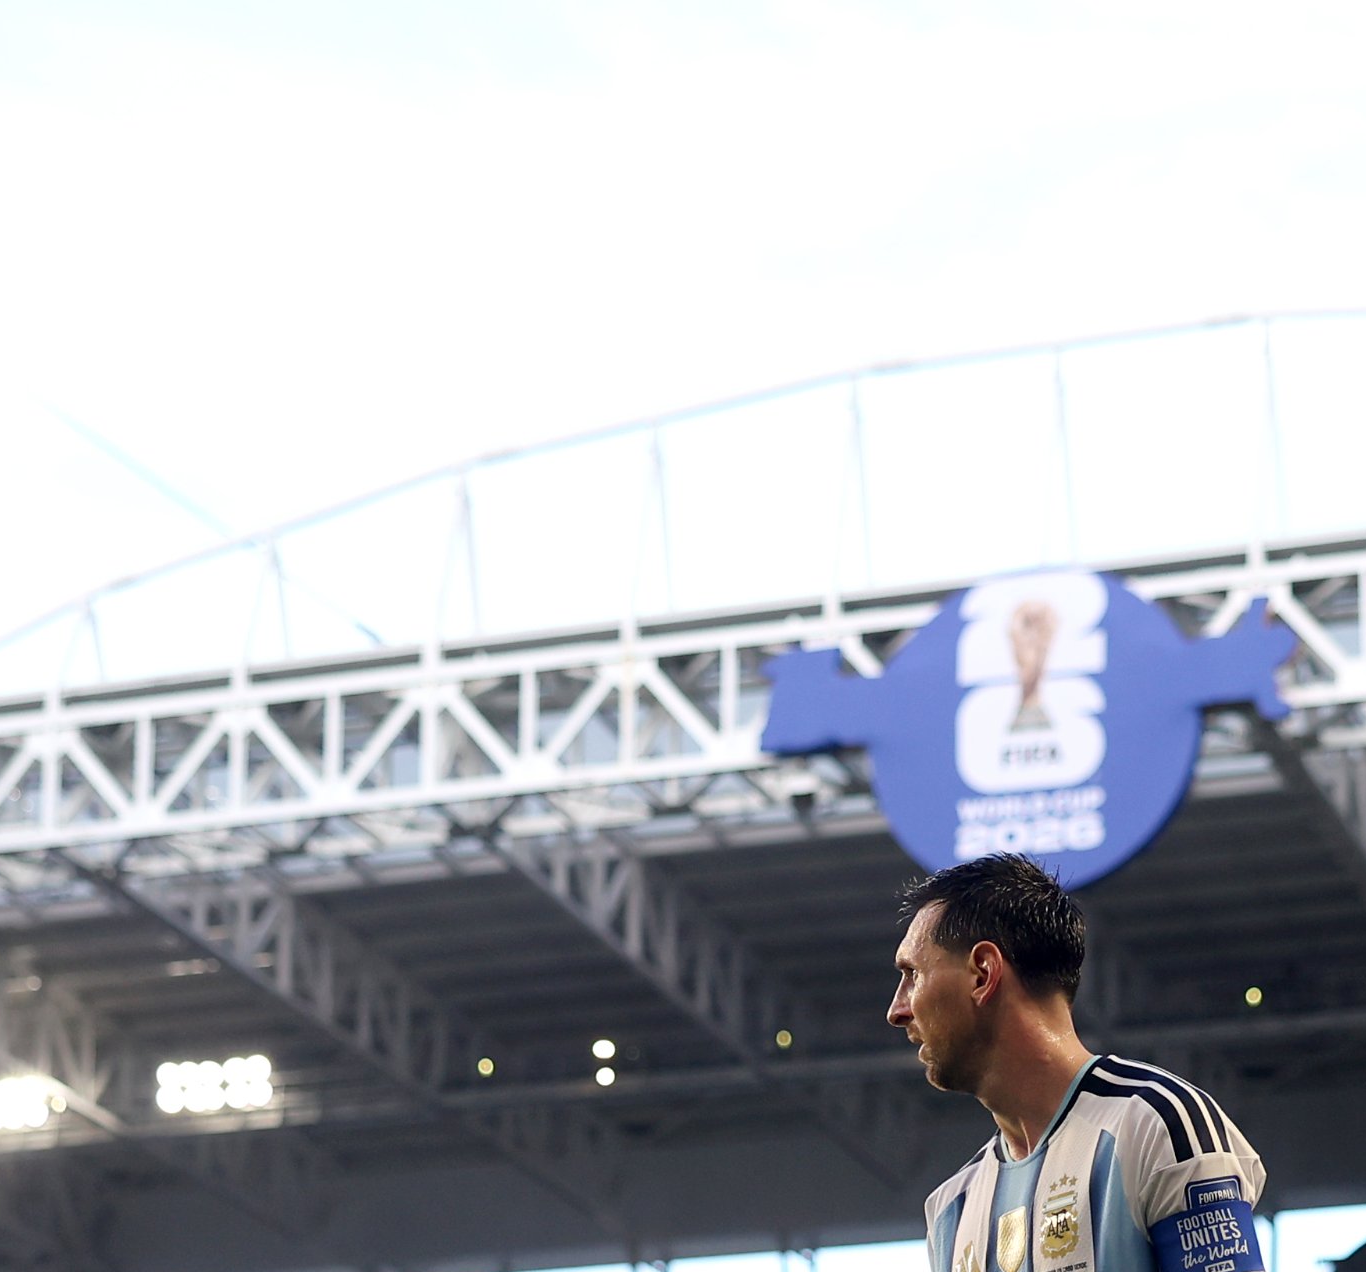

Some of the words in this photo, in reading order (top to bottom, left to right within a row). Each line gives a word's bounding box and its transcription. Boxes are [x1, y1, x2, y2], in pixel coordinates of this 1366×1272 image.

[954, 811, 1106, 860] 2026
[1198, 1188, 1235, 1205] FOOTBALL
[1177, 1208, 1236, 1234] FOOTBALL
[1180, 1221, 1242, 1251] UNITES
[1181, 1251, 1206, 1270] the
[1207, 1240, 1250, 1261] World
